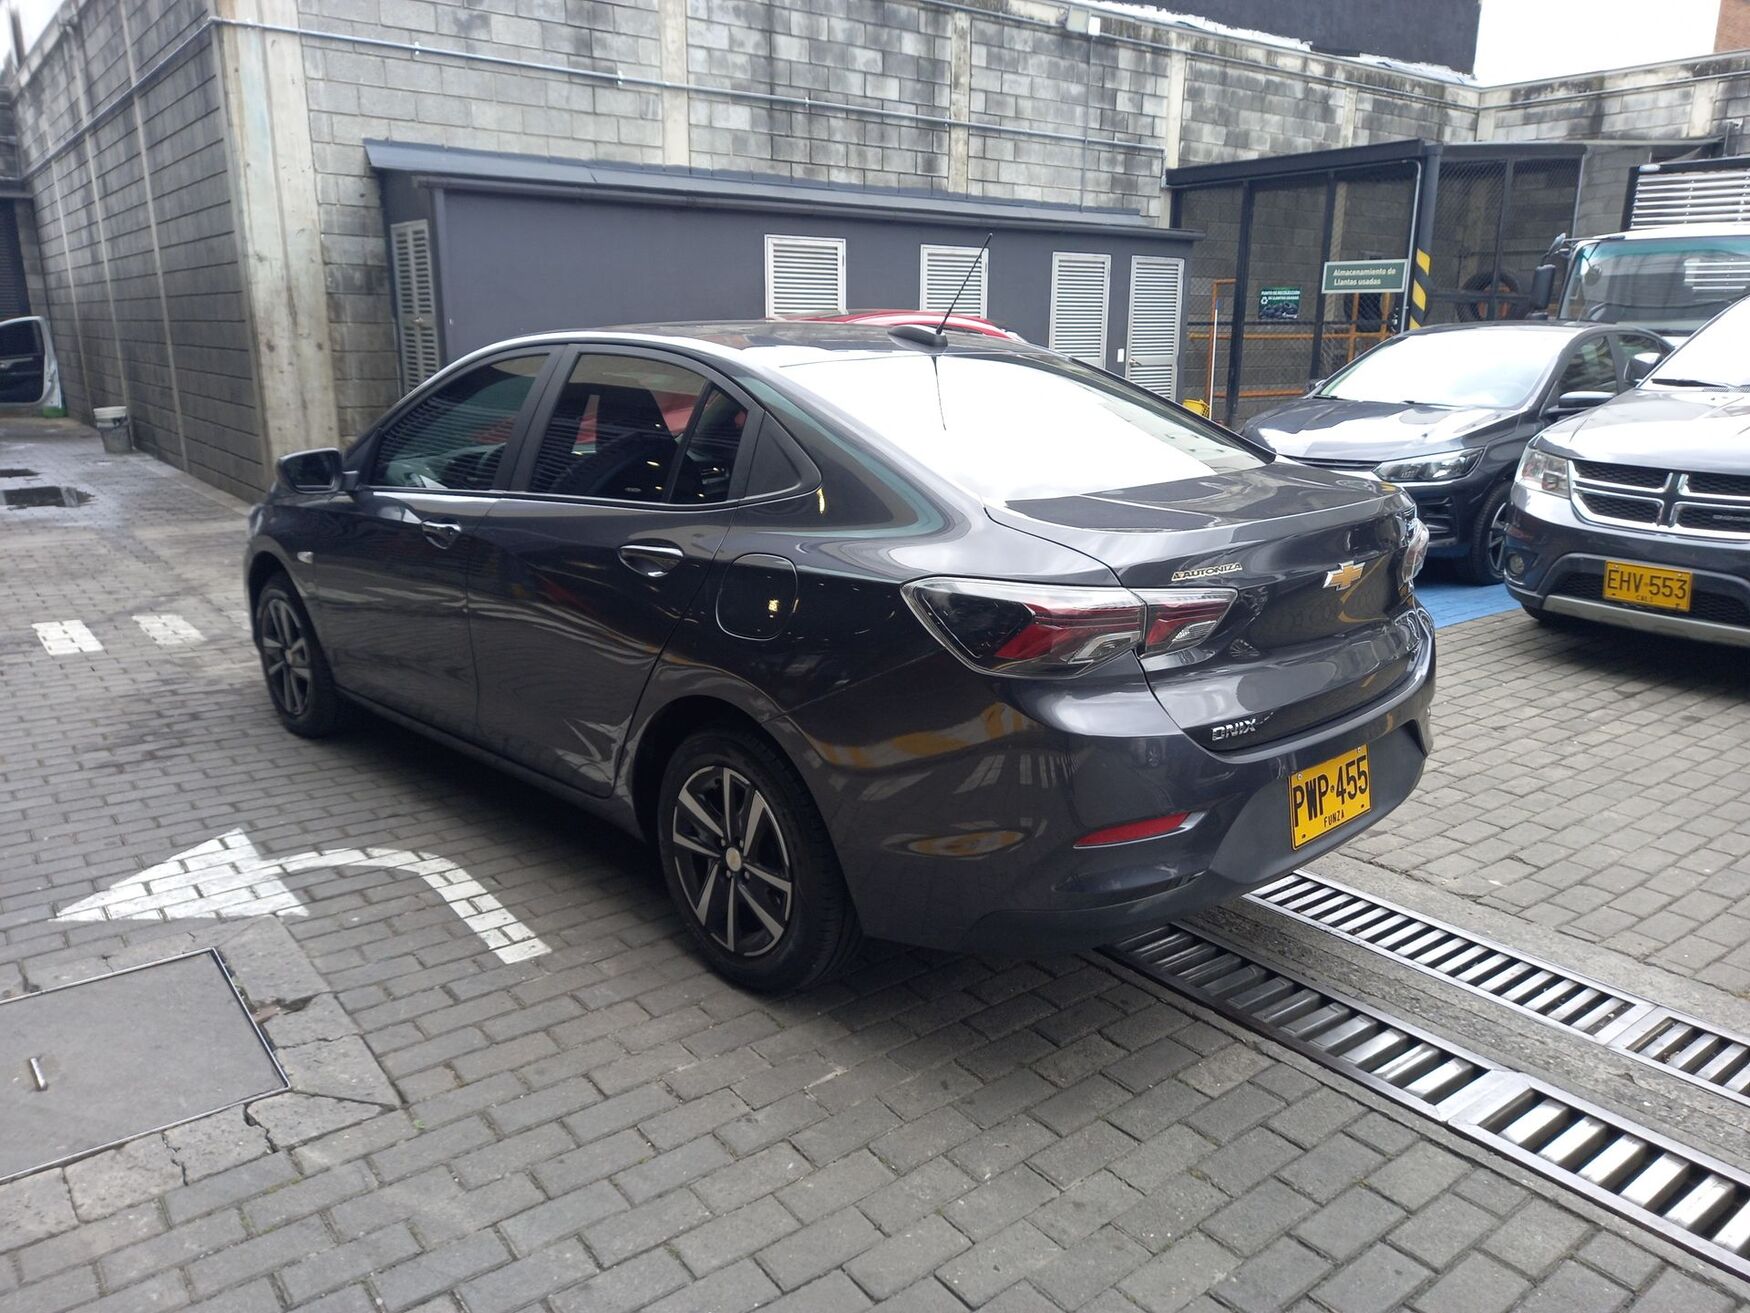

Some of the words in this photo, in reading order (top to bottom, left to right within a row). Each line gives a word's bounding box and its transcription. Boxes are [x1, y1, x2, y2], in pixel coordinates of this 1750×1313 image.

[1333, 267, 1386, 276] Almacenamiento
[1387, 267, 1396, 275] de
[1334, 278, 1357, 286] Llantas
[1358, 277, 1381, 285] usadas
[1607, 569, 1644, 593] EHV
[1648, 575, 1688, 600] 553
[1212, 718, 1257, 741] ONIX
[1323, 808, 1345, 828] FUNZA
